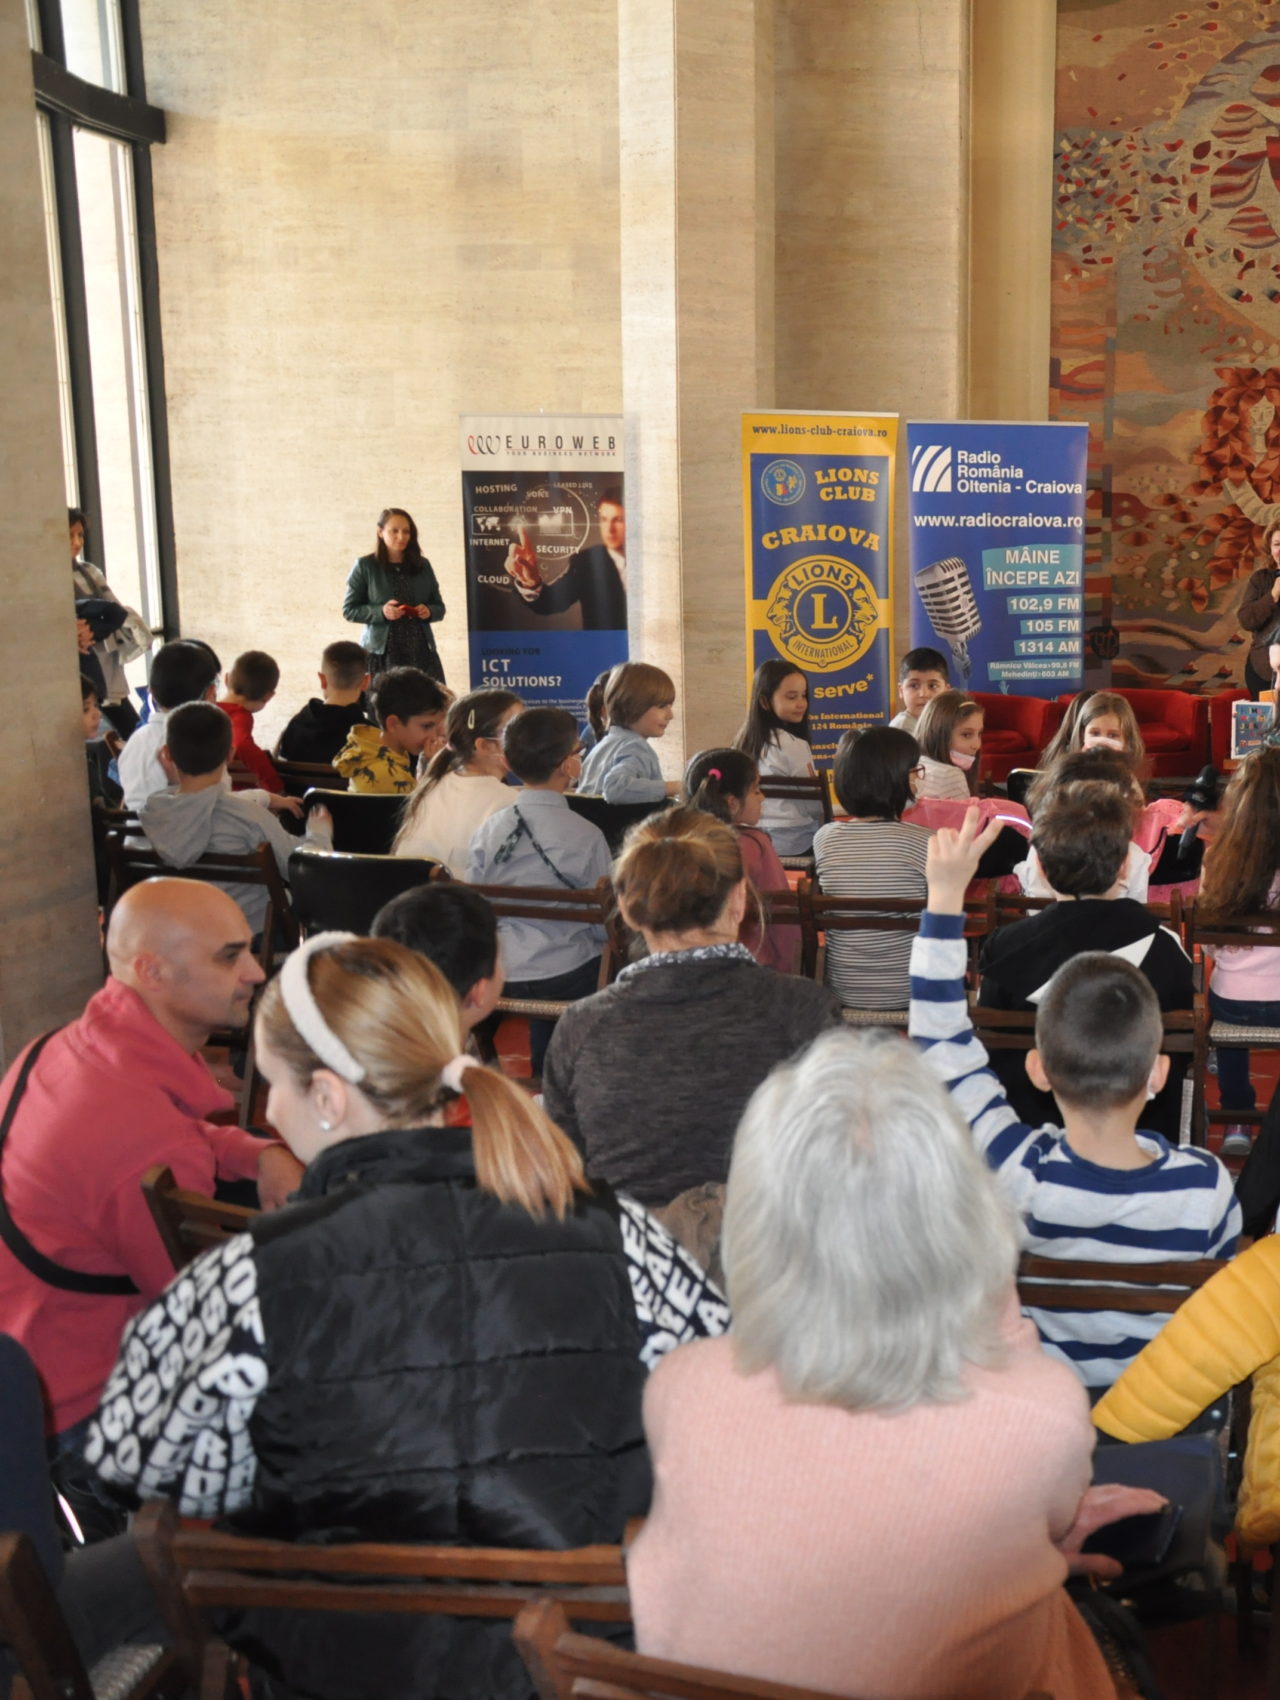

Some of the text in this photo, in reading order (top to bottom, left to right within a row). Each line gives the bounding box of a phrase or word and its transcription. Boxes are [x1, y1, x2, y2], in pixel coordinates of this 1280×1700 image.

[752, 424, 888, 438] www.lions-club-craiova.ro
[505, 435, 616, 450] EUROWEB
[957, 450, 1001, 464] Radio
[814, 468, 880, 485] LIONS
[957, 465, 1024, 478] România
[475, 484, 518, 494] HOSTING
[526, 490, 549, 498] VOICE
[819, 486, 876, 502] CLUB
[957, 480, 1011, 493] Oltenia
[1025, 480, 1082, 494] Craiova
[473, 505, 538, 513] COLLABORATION
[553, 506, 573, 514] VPN
[914, 513, 1083, 528] www.radiocraiova.ro
[470, 538, 510, 546] INTERNET
[761, 524, 880, 552] CRAIOVA
[536, 545, 580, 554] SECURITY
[1005, 546, 1060, 564] MÂINE
[477, 575, 510, 584] CLOUD
[792, 564, 854, 586] LIONS
[985, 567, 1079, 585] ÎNCEPE AZI
[810, 593, 839, 629] L
[1010, 598, 1079, 612] 102,9 FM
[1026, 620, 1079, 632] 105 FM
[792, 640, 854, 659] INTERNATIONAL
[1019, 641, 1079, 653] 1314 AM
[482, 659, 511, 672] ICT
[482, 675, 562, 687] SOLUTIONS?
[821, 712, 884, 720] International
